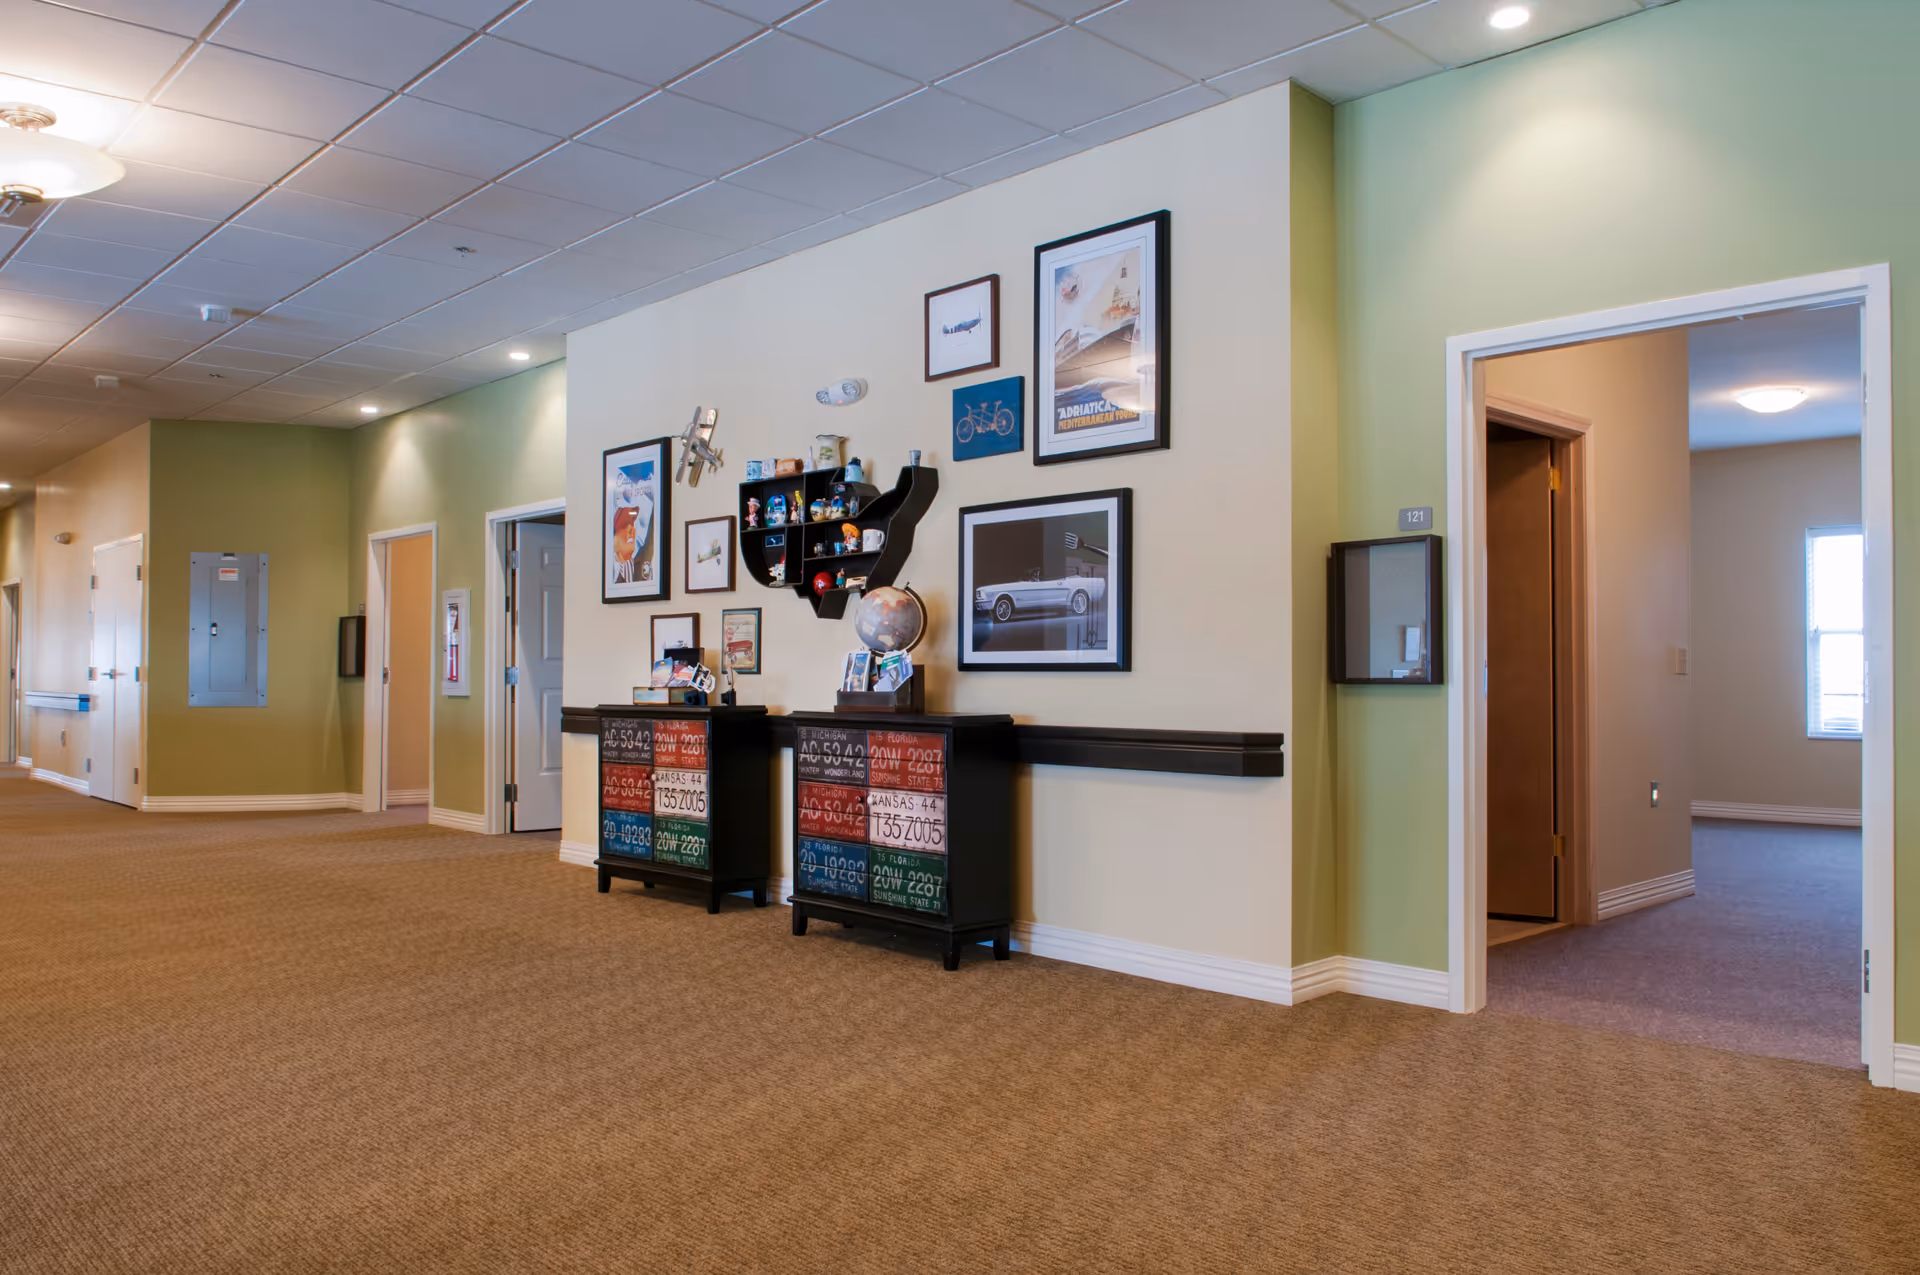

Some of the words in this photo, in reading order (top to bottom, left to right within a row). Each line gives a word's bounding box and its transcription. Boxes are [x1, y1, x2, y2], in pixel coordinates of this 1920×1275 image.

[1406, 510, 1424, 523] 121
[655, 732, 677, 753] 20W
[681, 733, 705, 756] 2287
[811, 729, 847, 741] MICHIGAN
[887, 734, 919, 746] FLORIDA
[823, 741, 865, 768] 5342
[870, 744, 901, 771] 20W
[907, 747, 942, 775] 2287
[872, 770, 901, 785] SUNSHINE
[907, 774, 929, 787] STATE
[812, 787, 848, 800] MICHIGAN
[824, 800, 865, 827] 5342
[921, 797, 938, 813] 44
[656, 830, 678, 852] 20W
[680, 834, 706, 856] 2287
[815, 842, 843, 854] FLORIDA
[800, 848, 817, 873] 2D
[824, 855, 866, 885] 19283
[889, 854, 921, 867] FLORIDA
[872, 864, 903, 891] 20W
[907, 870, 943, 899] 2287
[873, 889, 907, 905] SUNSHINE
[909, 895, 930, 908] STATE
